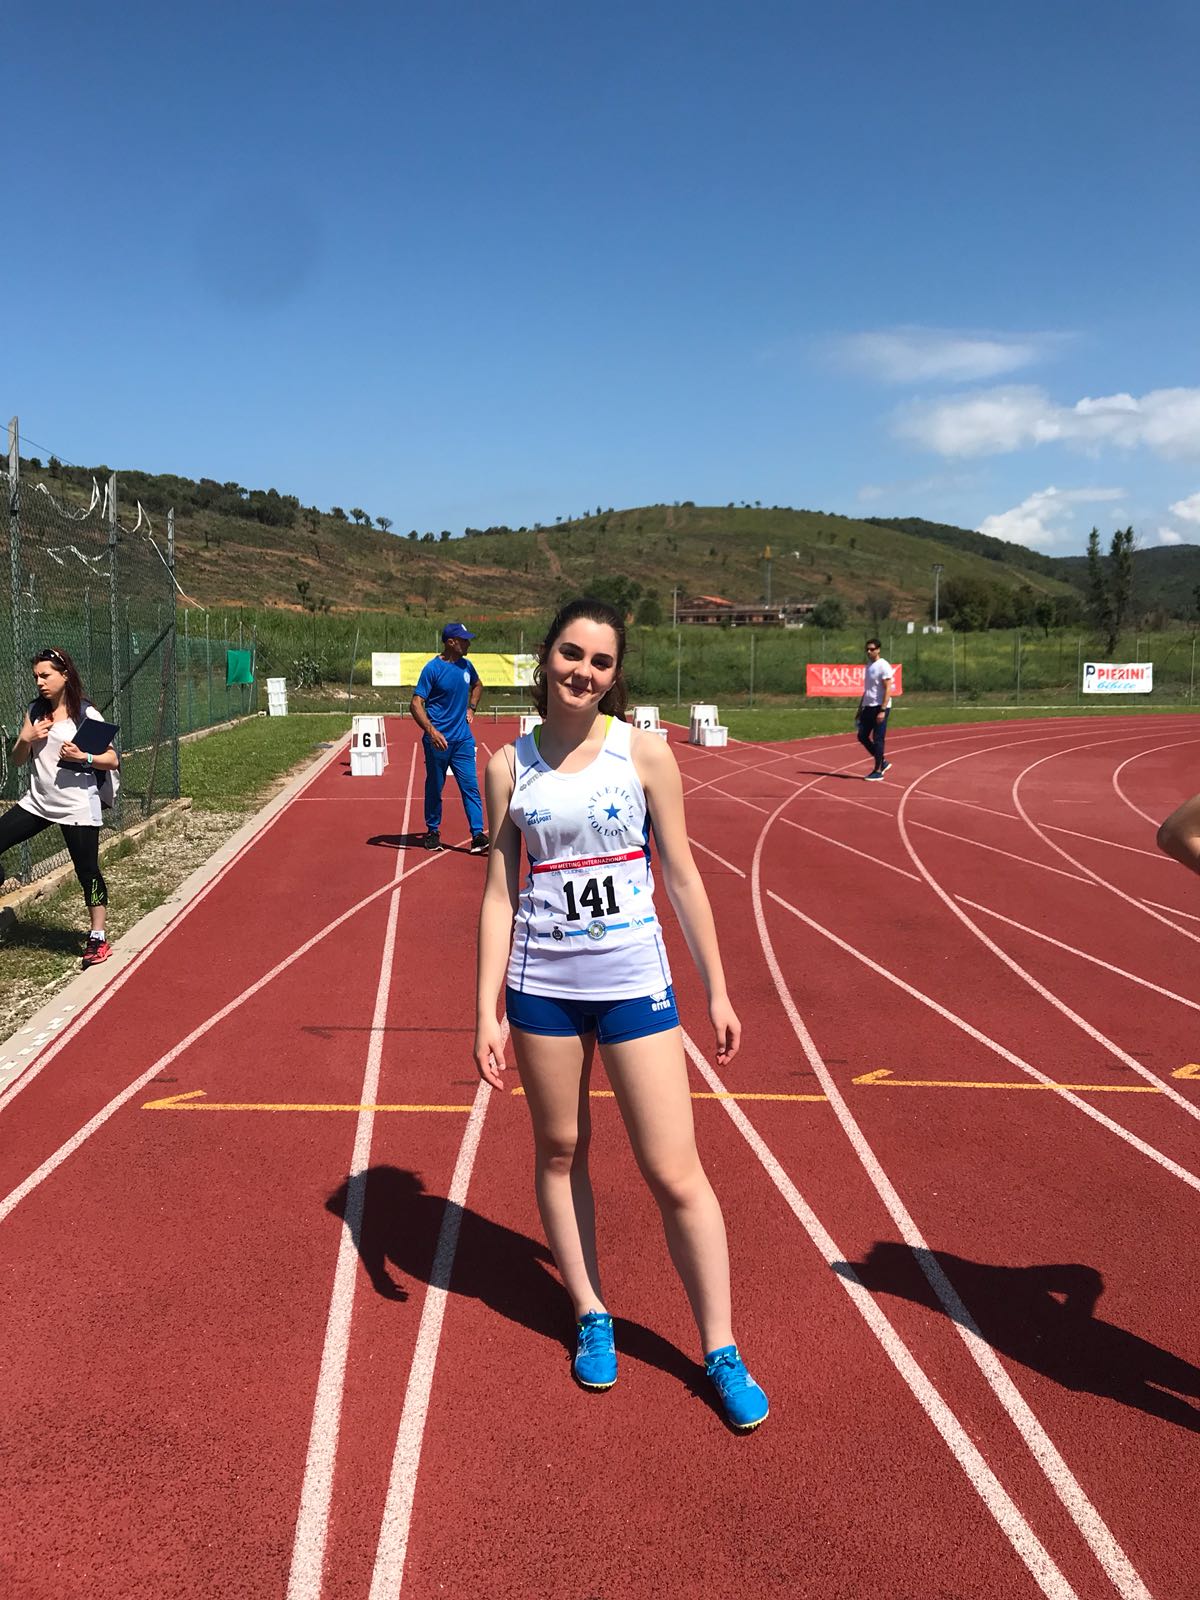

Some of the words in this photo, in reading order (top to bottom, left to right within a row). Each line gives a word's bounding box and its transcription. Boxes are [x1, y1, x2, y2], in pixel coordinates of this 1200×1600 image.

[822, 667, 866, 680] BARB
[1097, 668, 1145, 680] PIERINI
[644, 720, 651, 729] 2
[704, 718, 710, 727] 1
[362, 732, 371, 747] 6
[558, 860, 582, 869] MEETING
[581, 854, 628, 867] INTERNAZIONALE
[562, 875, 620, 921] 141
